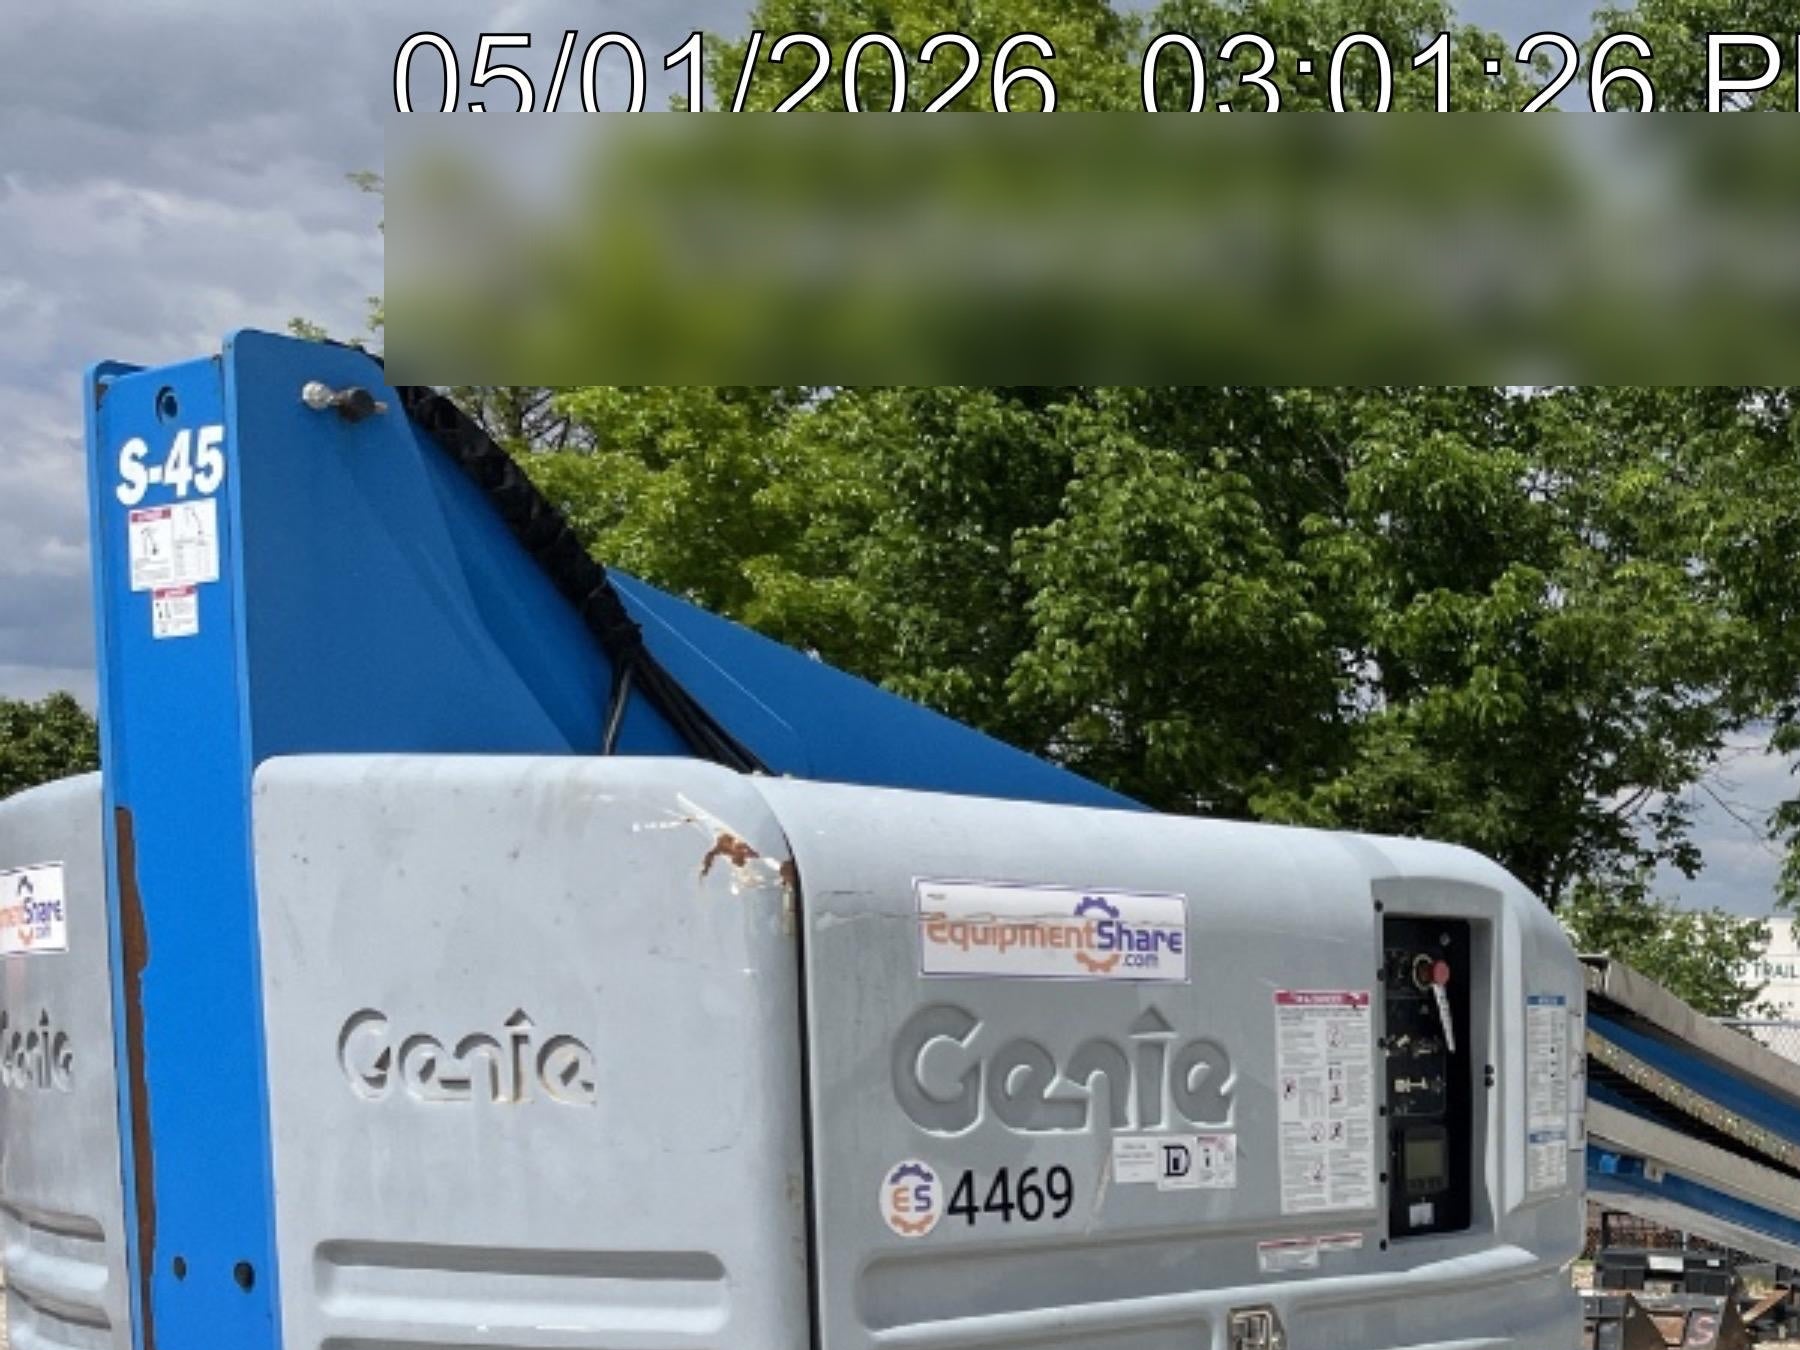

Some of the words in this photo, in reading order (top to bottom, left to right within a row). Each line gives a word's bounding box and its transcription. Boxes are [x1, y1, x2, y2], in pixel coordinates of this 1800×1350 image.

[116, 424, 225, 506] S-45
[1753, 961, 1800, 979] TRAIL
[337, 1007, 597, 1105] Genie
[891, 1002, 1237, 1137] Genie
[892, 1185, 932, 1213] ES
[947, 1164, 1075, 1226] 4469
